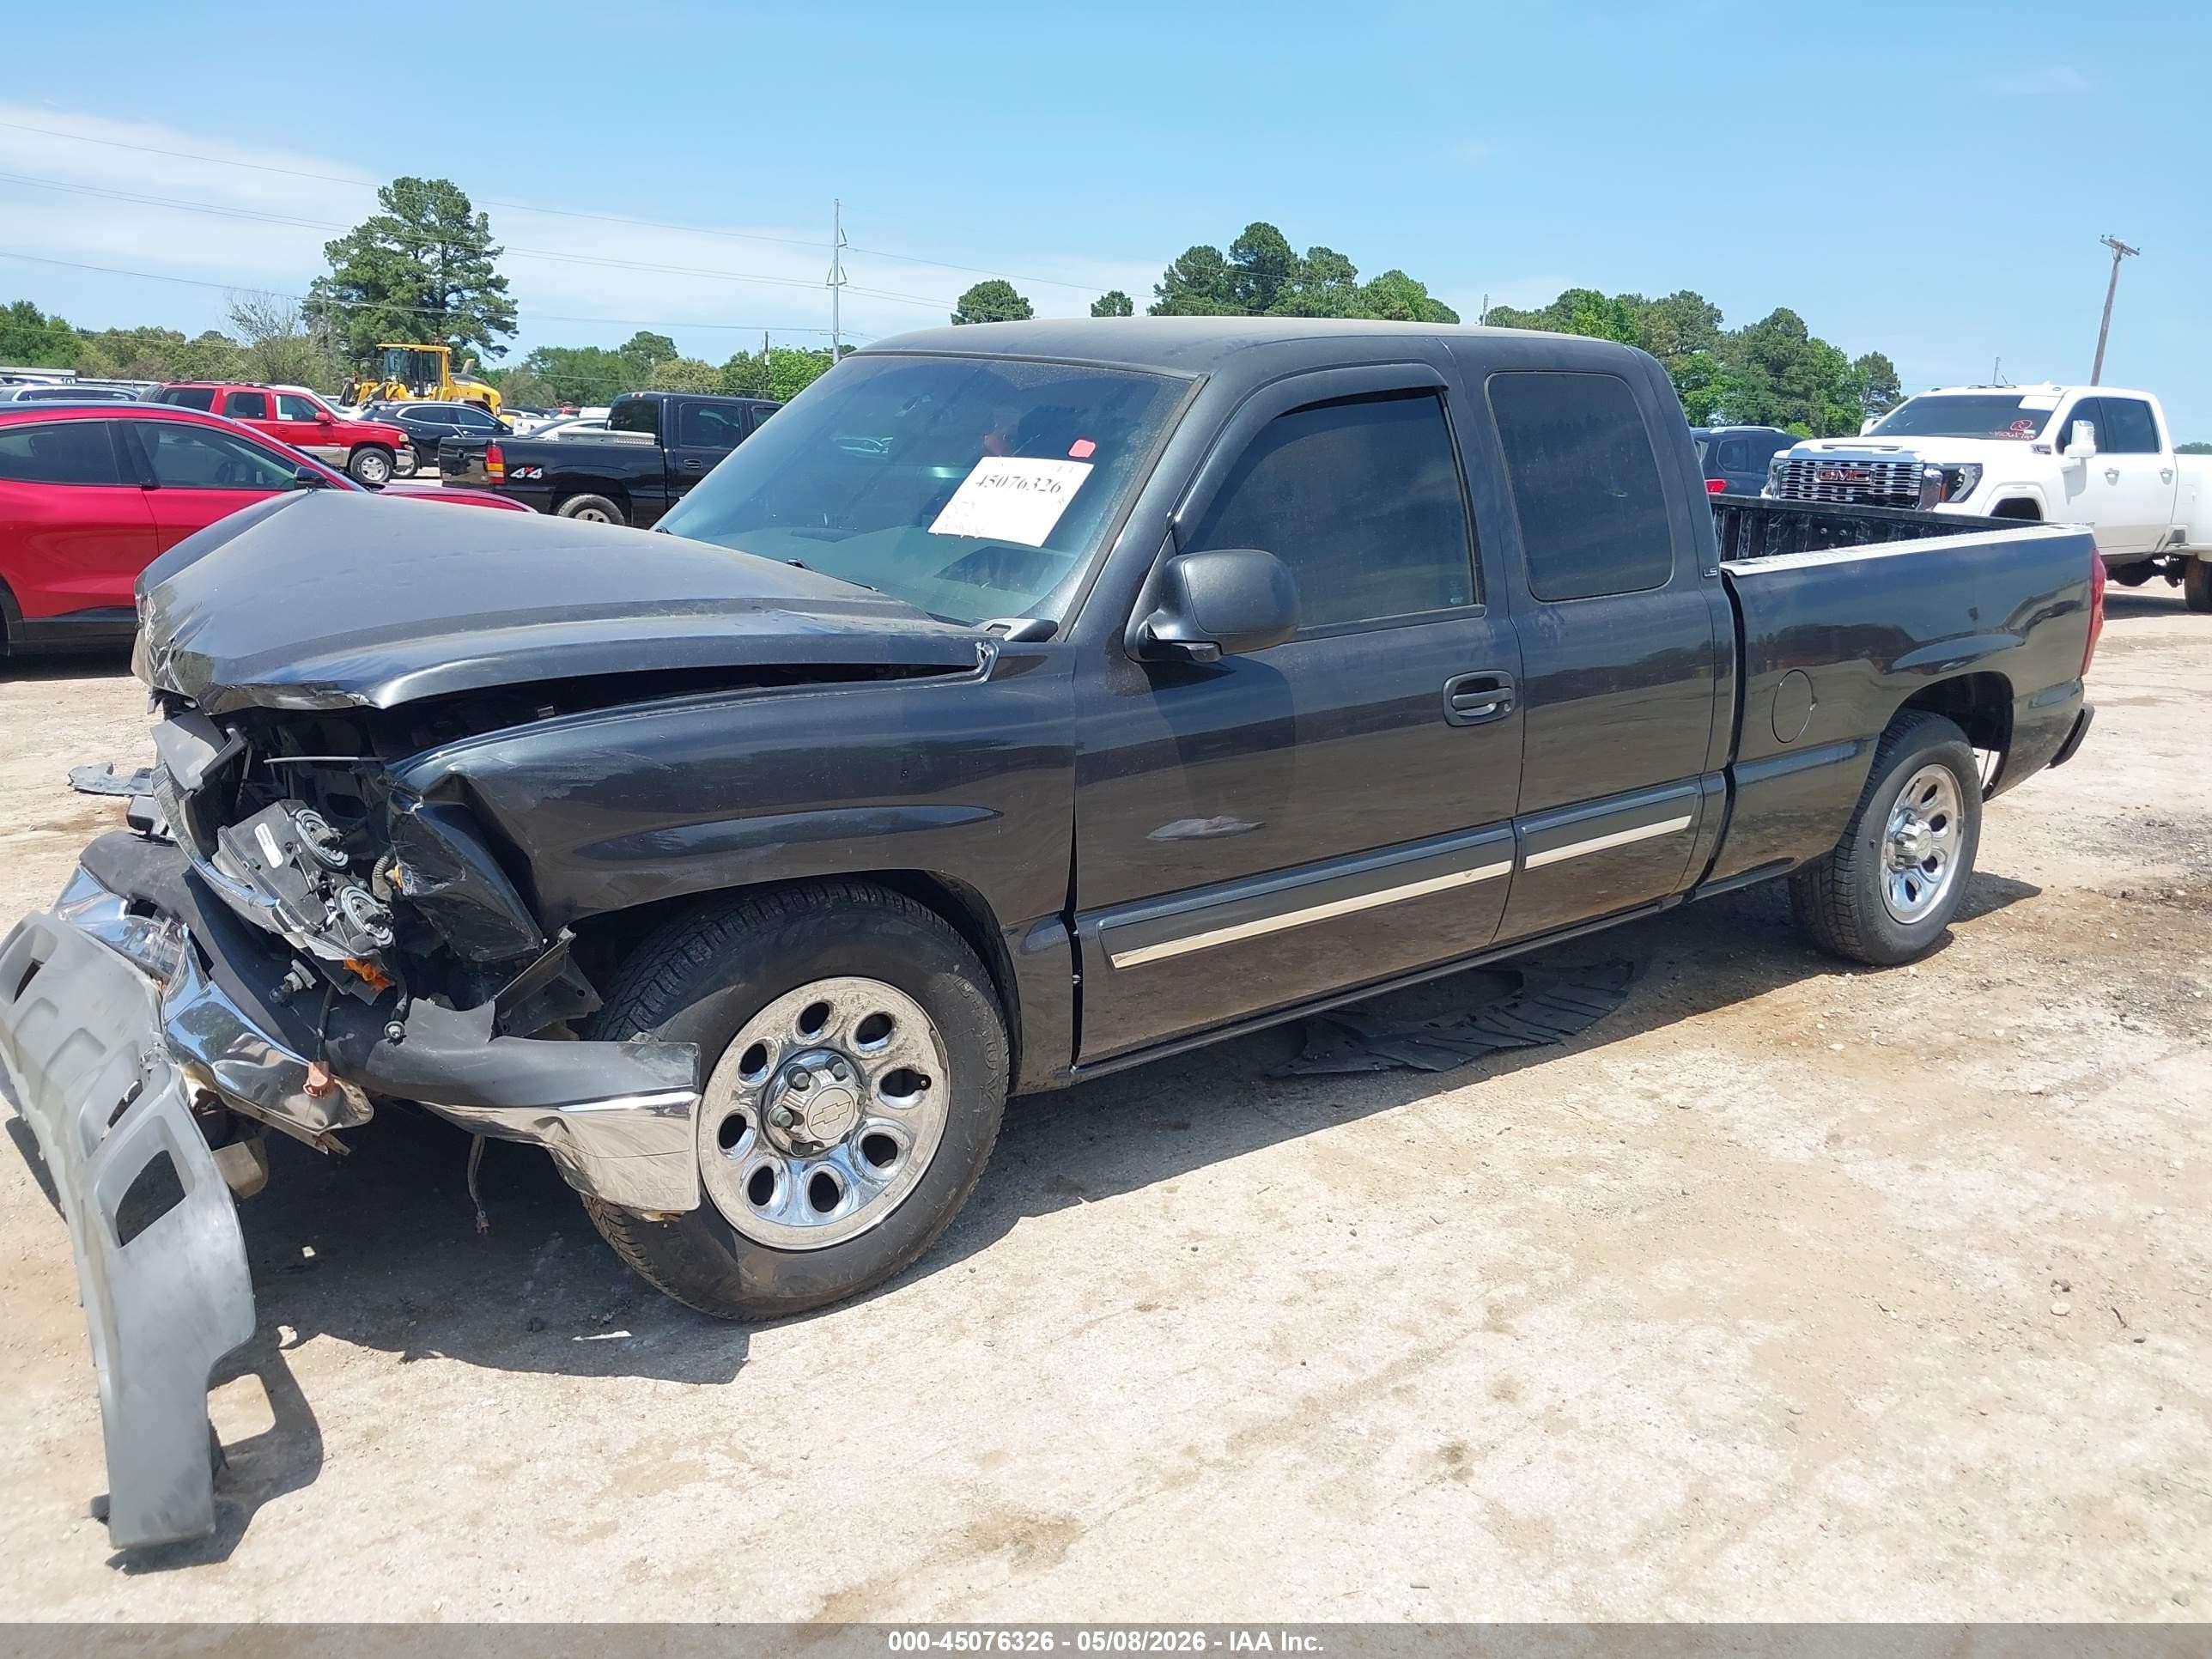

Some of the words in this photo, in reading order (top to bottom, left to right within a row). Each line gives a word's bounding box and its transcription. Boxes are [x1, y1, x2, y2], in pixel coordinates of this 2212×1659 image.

[1820, 469, 1869, 481] GMC
[975, 474, 1062, 494] 45076326
[1703, 567, 1717, 577] LS
